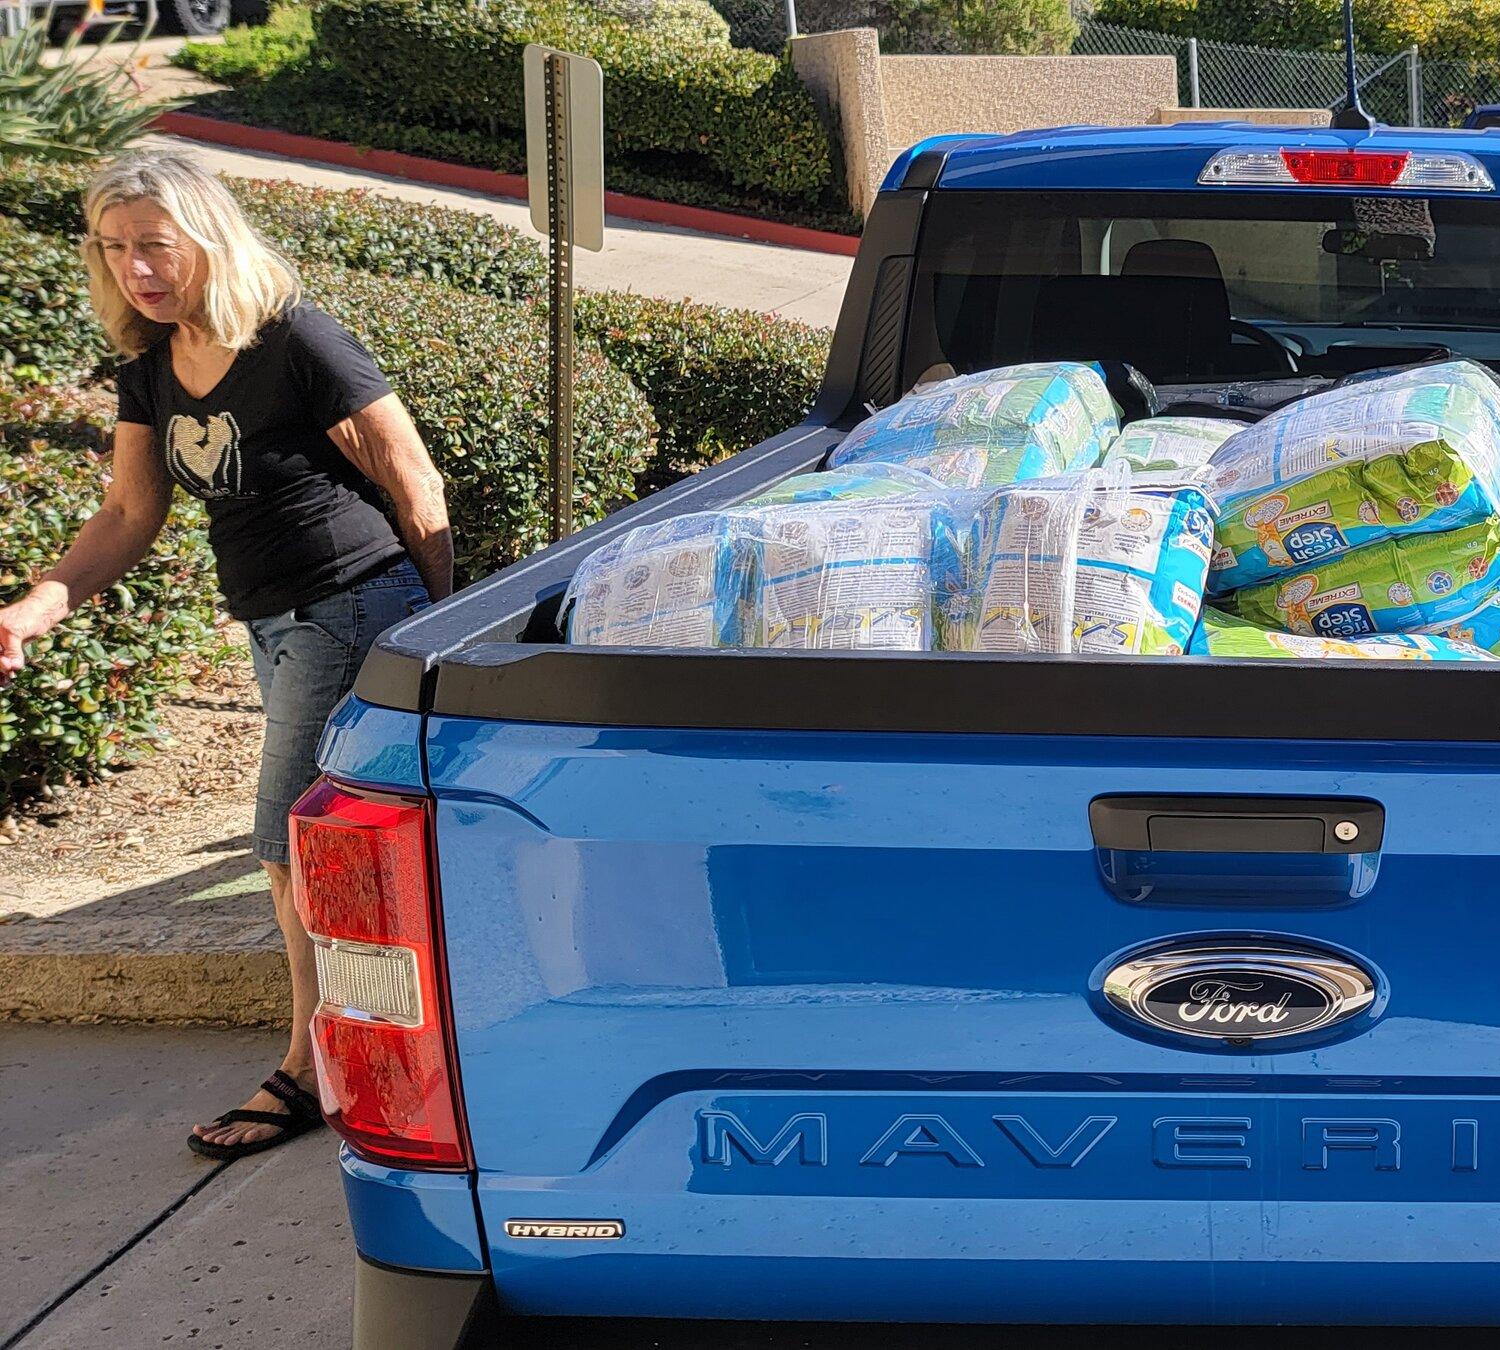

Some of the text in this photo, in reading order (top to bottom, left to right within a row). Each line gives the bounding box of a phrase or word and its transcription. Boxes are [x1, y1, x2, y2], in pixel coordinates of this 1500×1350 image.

[1279, 505, 1327, 527] EXTREME
[1290, 526, 1334, 549] Step
[1294, 538, 1343, 560] Fresh
[1308, 585, 1356, 608] EXTREME
[1319, 607, 1363, 629] Step
[1178, 979, 1291, 1024] Ford
[511, 1225, 617, 1237] HYBRID
